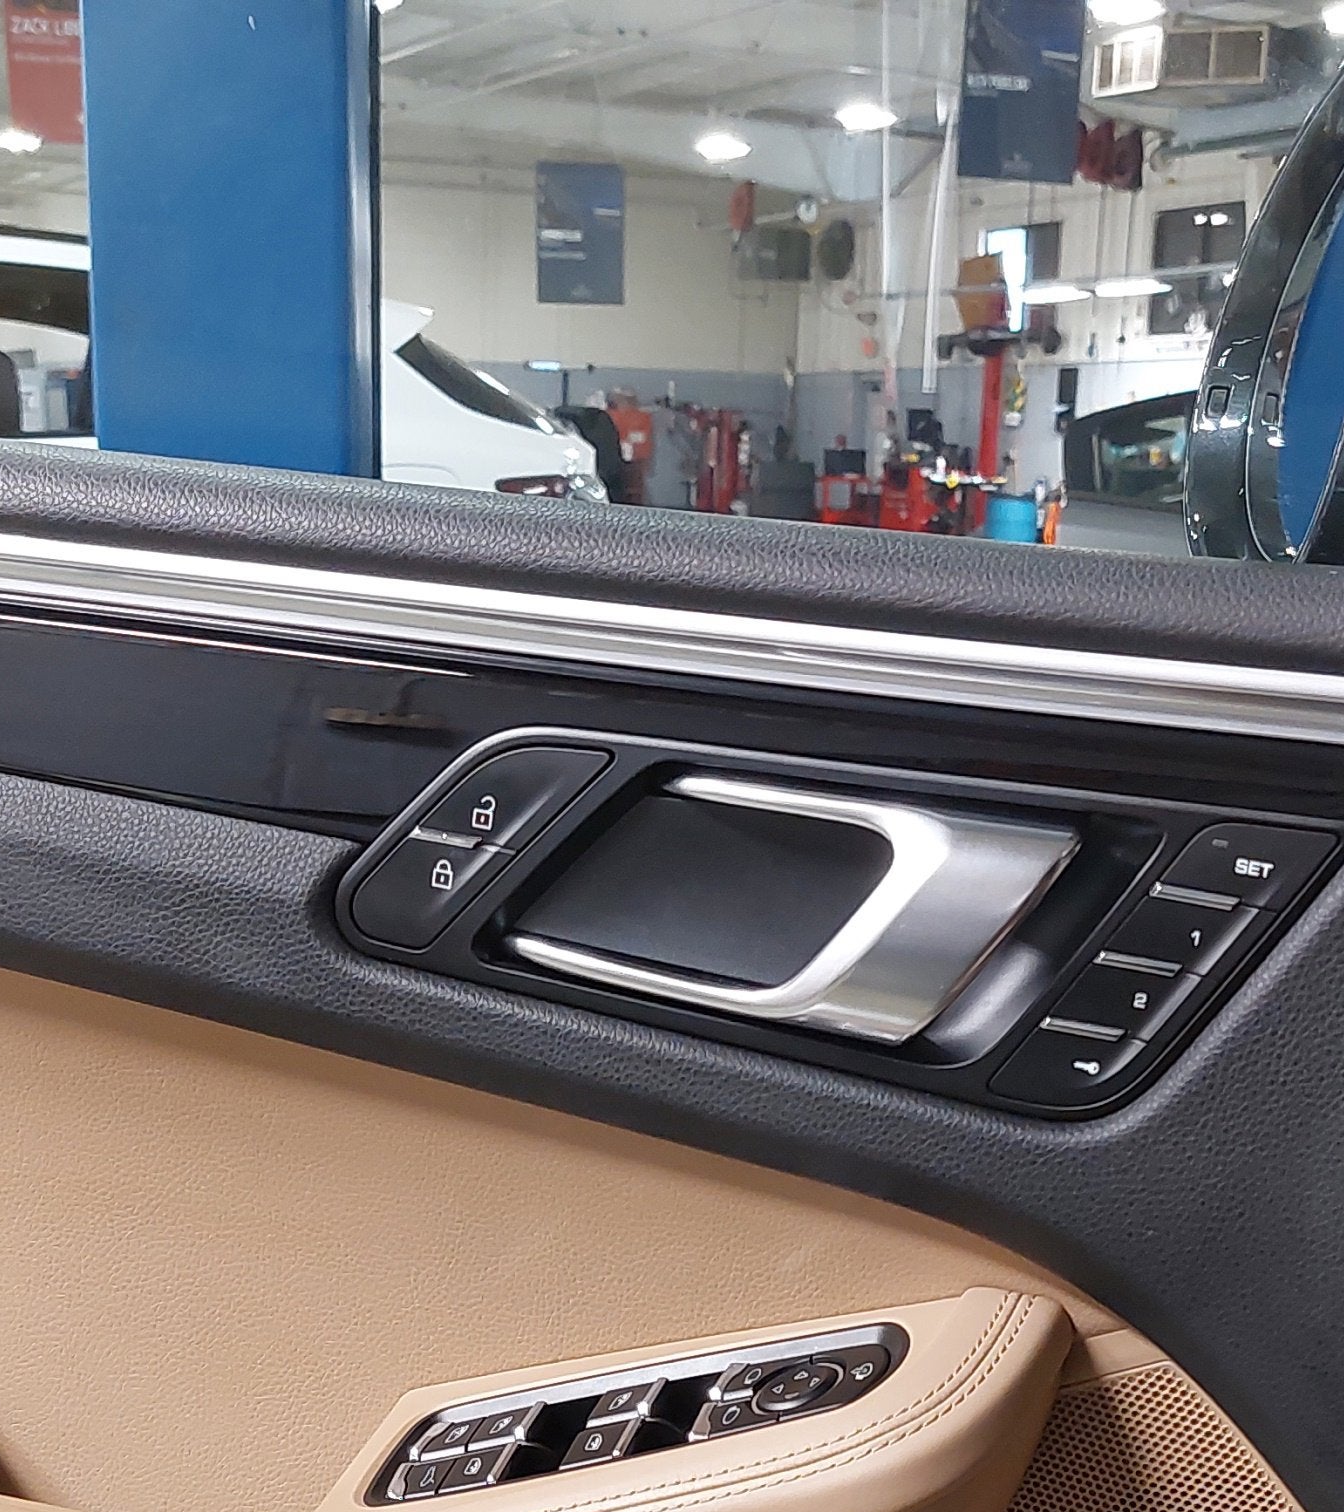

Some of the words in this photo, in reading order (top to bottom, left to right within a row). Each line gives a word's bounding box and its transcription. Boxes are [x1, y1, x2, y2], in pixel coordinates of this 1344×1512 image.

[1234, 858, 1274, 879] SET
[1190, 930, 1202, 947] 1
[1132, 992, 1148, 1009] 2
